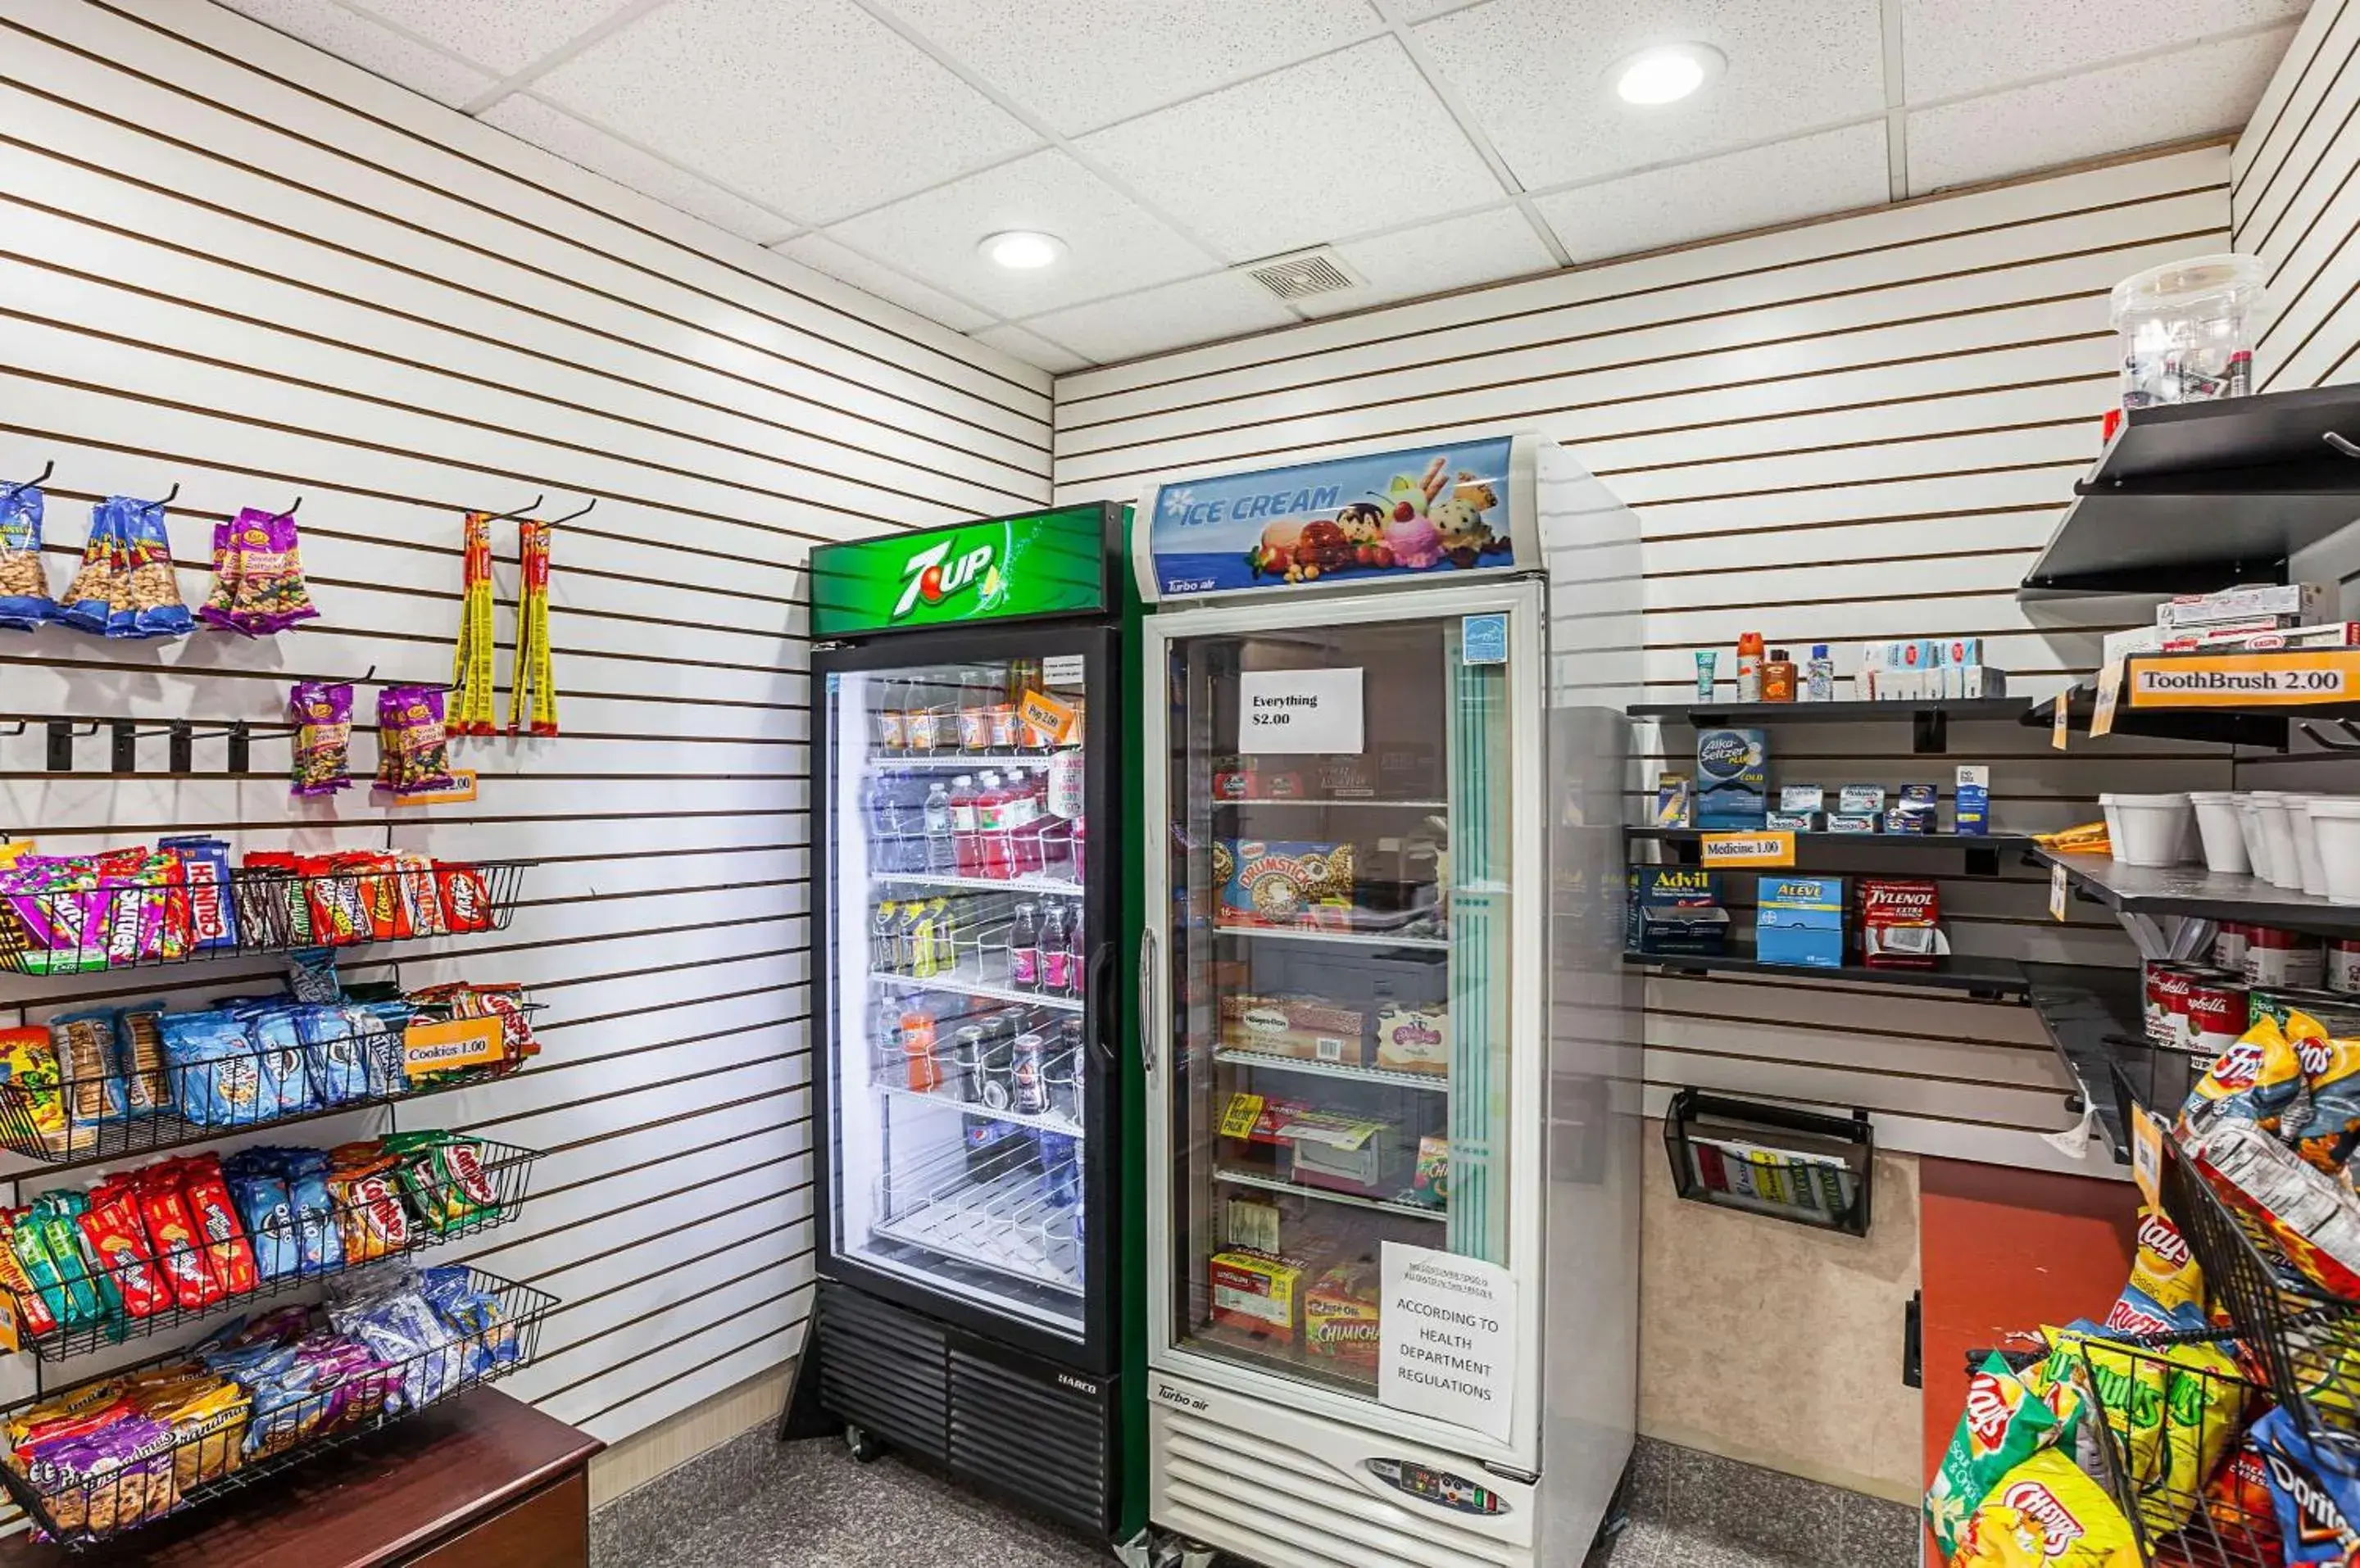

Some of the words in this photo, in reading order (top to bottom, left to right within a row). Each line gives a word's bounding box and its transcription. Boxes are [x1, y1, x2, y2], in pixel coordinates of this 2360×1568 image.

[1180, 500, 1226, 527] ICE
[1232, 483, 1342, 520] CREAM
[892, 539, 994, 617] 7UP
[1168, 579, 1198, 592] Turbo
[1200, 578, 1214, 590] air
[2144, 671, 2276, 690] ToothBrush
[2285, 672, 2339, 690] 2.00
[1253, 694, 1318, 708] Everything
[1252, 714, 1290, 725] $2.00
[1701, 746, 1745, 762] Seltzer
[1704, 740, 1737, 750] Alka-
[1708, 842, 1754, 854] Medicine
[1757, 841, 1779, 854] 1.00
[1239, 856, 1313, 890] DRUMSTICK
[1654, 871, 1709, 888] Advil
[189, 863, 224, 936] CRUNCH
[1868, 890, 1932, 908] TYLENOL
[410, 1045, 459, 1061] Cookies
[461, 1040, 486, 1054] 1.00
[1396, 1298, 1476, 1327] ACCORDING
[1480, 1317, 1499, 1334] TO
[1420, 1327, 1472, 1350] HEALTH
[1400, 1344, 1492, 1377] DEPARTMENT
[1398, 1366, 1491, 1401] REGULATIONS
[1158, 1383, 1190, 1406] Turbo
[1191, 1398, 1210, 1412] air
